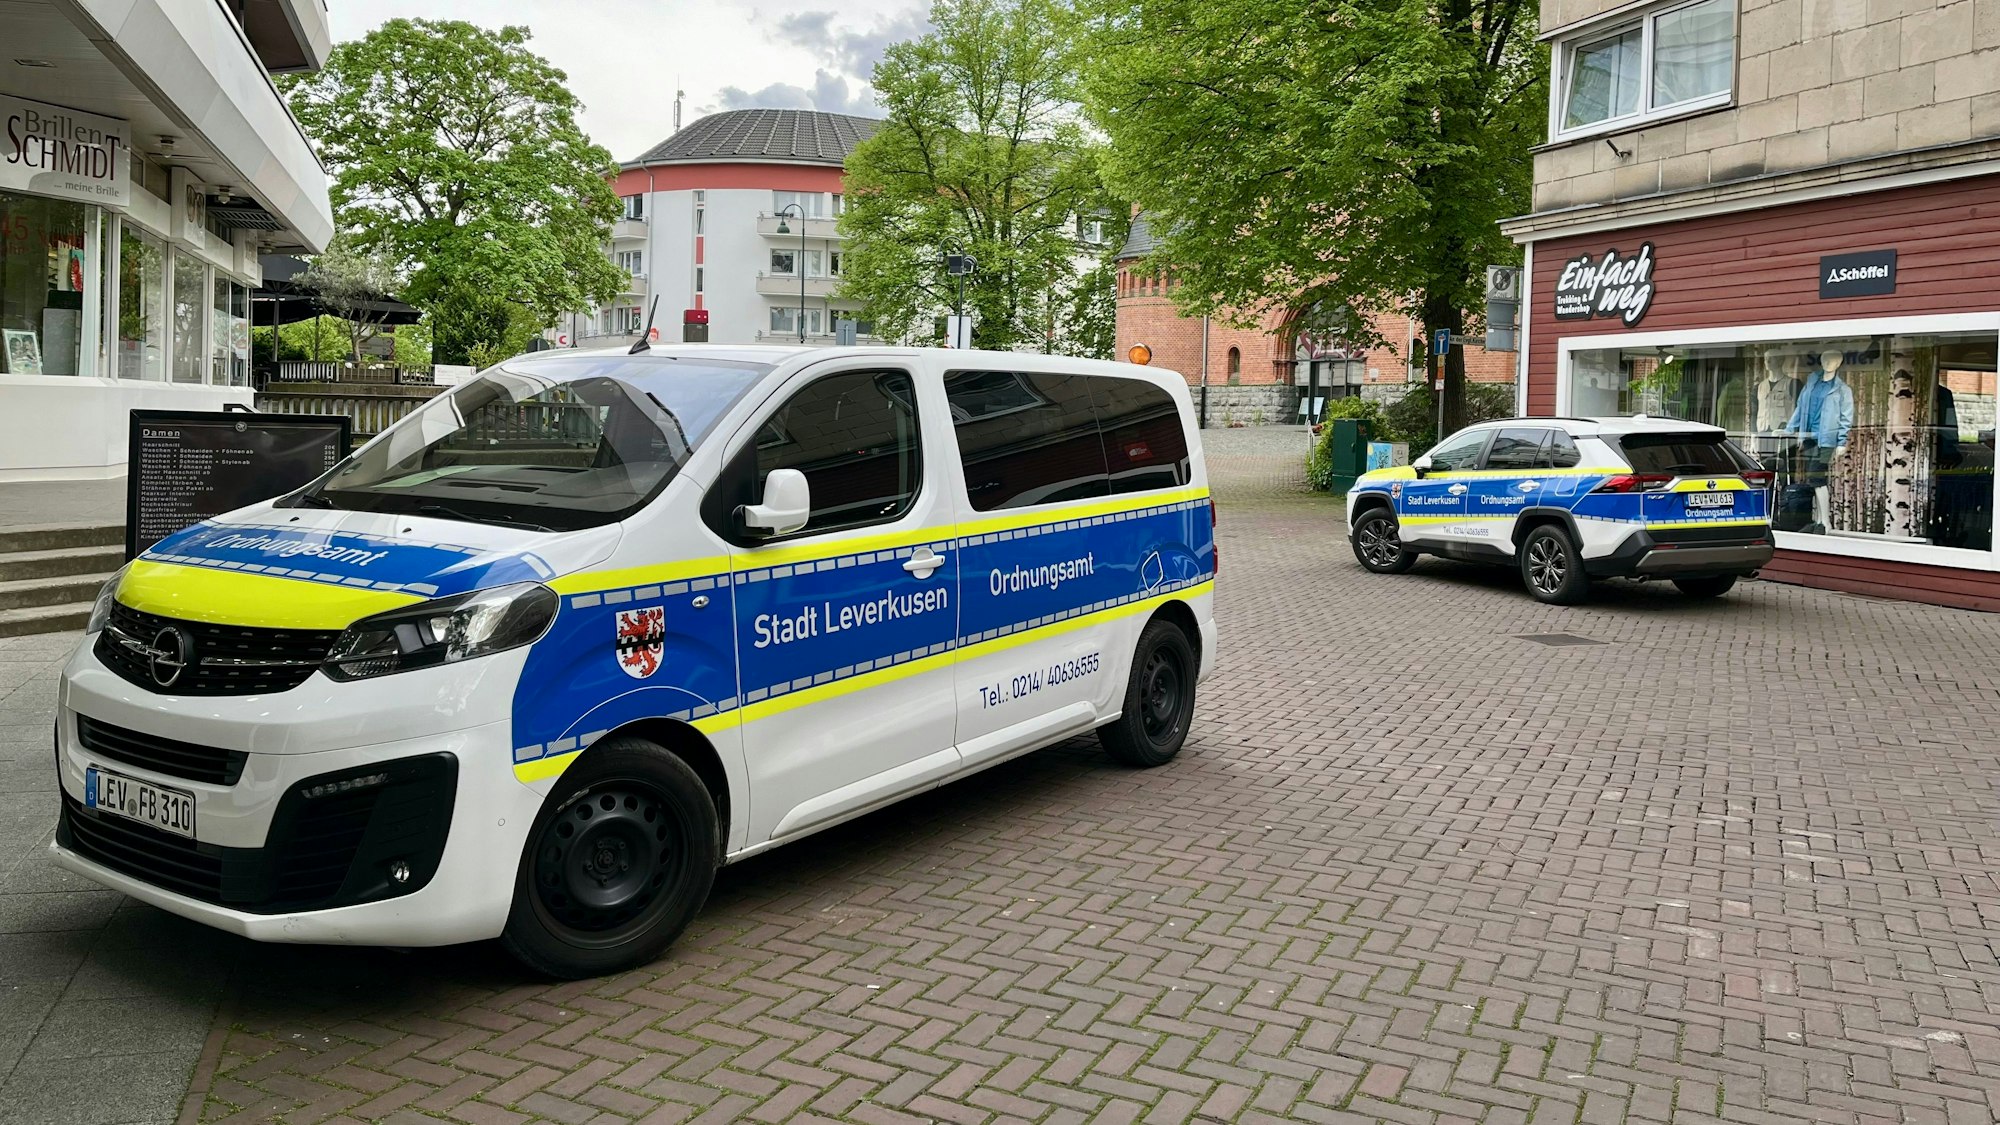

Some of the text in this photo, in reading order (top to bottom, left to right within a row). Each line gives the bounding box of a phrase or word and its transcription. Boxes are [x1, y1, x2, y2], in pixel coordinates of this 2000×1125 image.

[24, 109, 100, 143] Brillen
[7, 115, 121, 181] SCHMIDT
[65, 181, 93, 193] meine
[96, 184, 119, 197] Brille
[1557, 245, 1651, 301] Einfach
[1839, 264, 1889, 281] Schöffel
[1557, 294, 1581, 305] Trekking
[1557, 304, 1591, 315] Wandershop
[1598, 284, 1651, 322] weg
[142, 428, 180, 437] Damen
[1407, 495, 1460, 506] Stadt Leverkusen
[1480, 494, 1526, 507] Ordnungsamt
[1689, 493, 1704, 506] LEV
[1720, 492, 1733, 504] 613
[1685, 507, 1734, 519] Ordnungsamt
[205, 533, 389, 567] Ordnungsamt
[989, 551, 1095, 597] Ordnungsamt
[753, 586, 948, 649] Stadt Leverkusen
[980, 652, 1100, 710] Tel.: 0214/ 40636555
[97, 775, 190, 831] LEV FB 310
